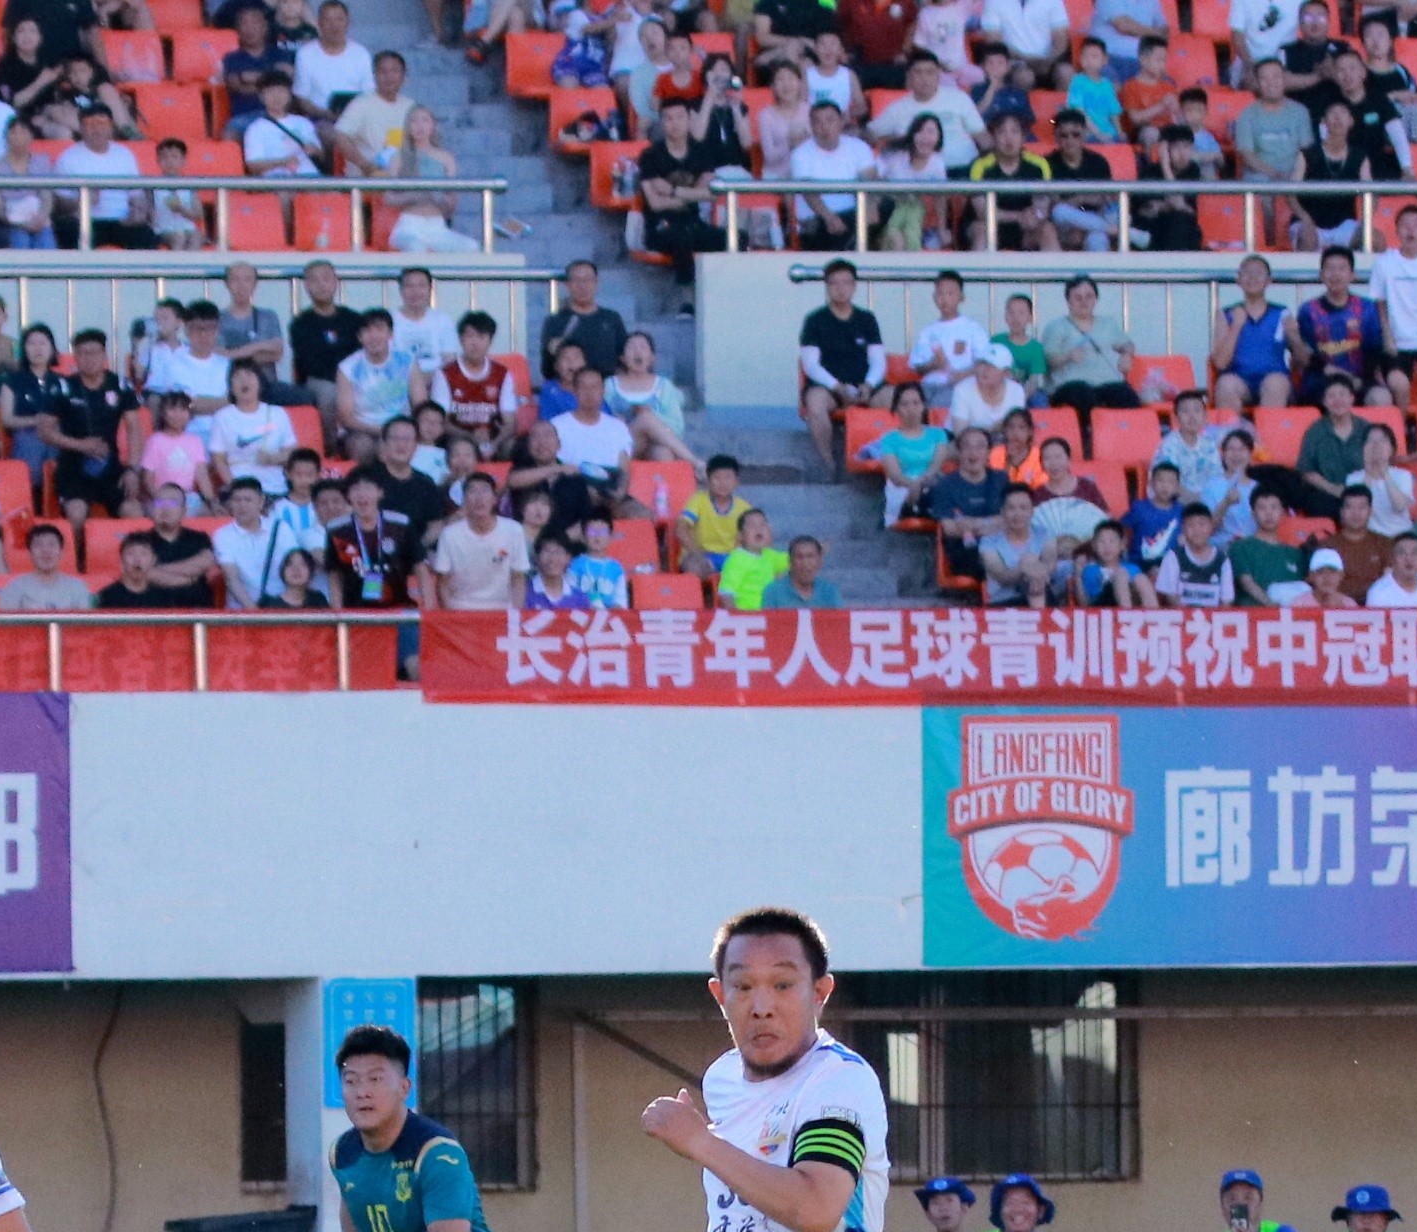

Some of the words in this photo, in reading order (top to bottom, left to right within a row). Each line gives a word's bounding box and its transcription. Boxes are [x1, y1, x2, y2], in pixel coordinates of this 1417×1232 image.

[978, 731, 1103, 779] LANGFANG
[954, 784, 1007, 826] CITY
[1013, 781, 1044, 813] OF
[1050, 781, 1127, 824] GLORY
